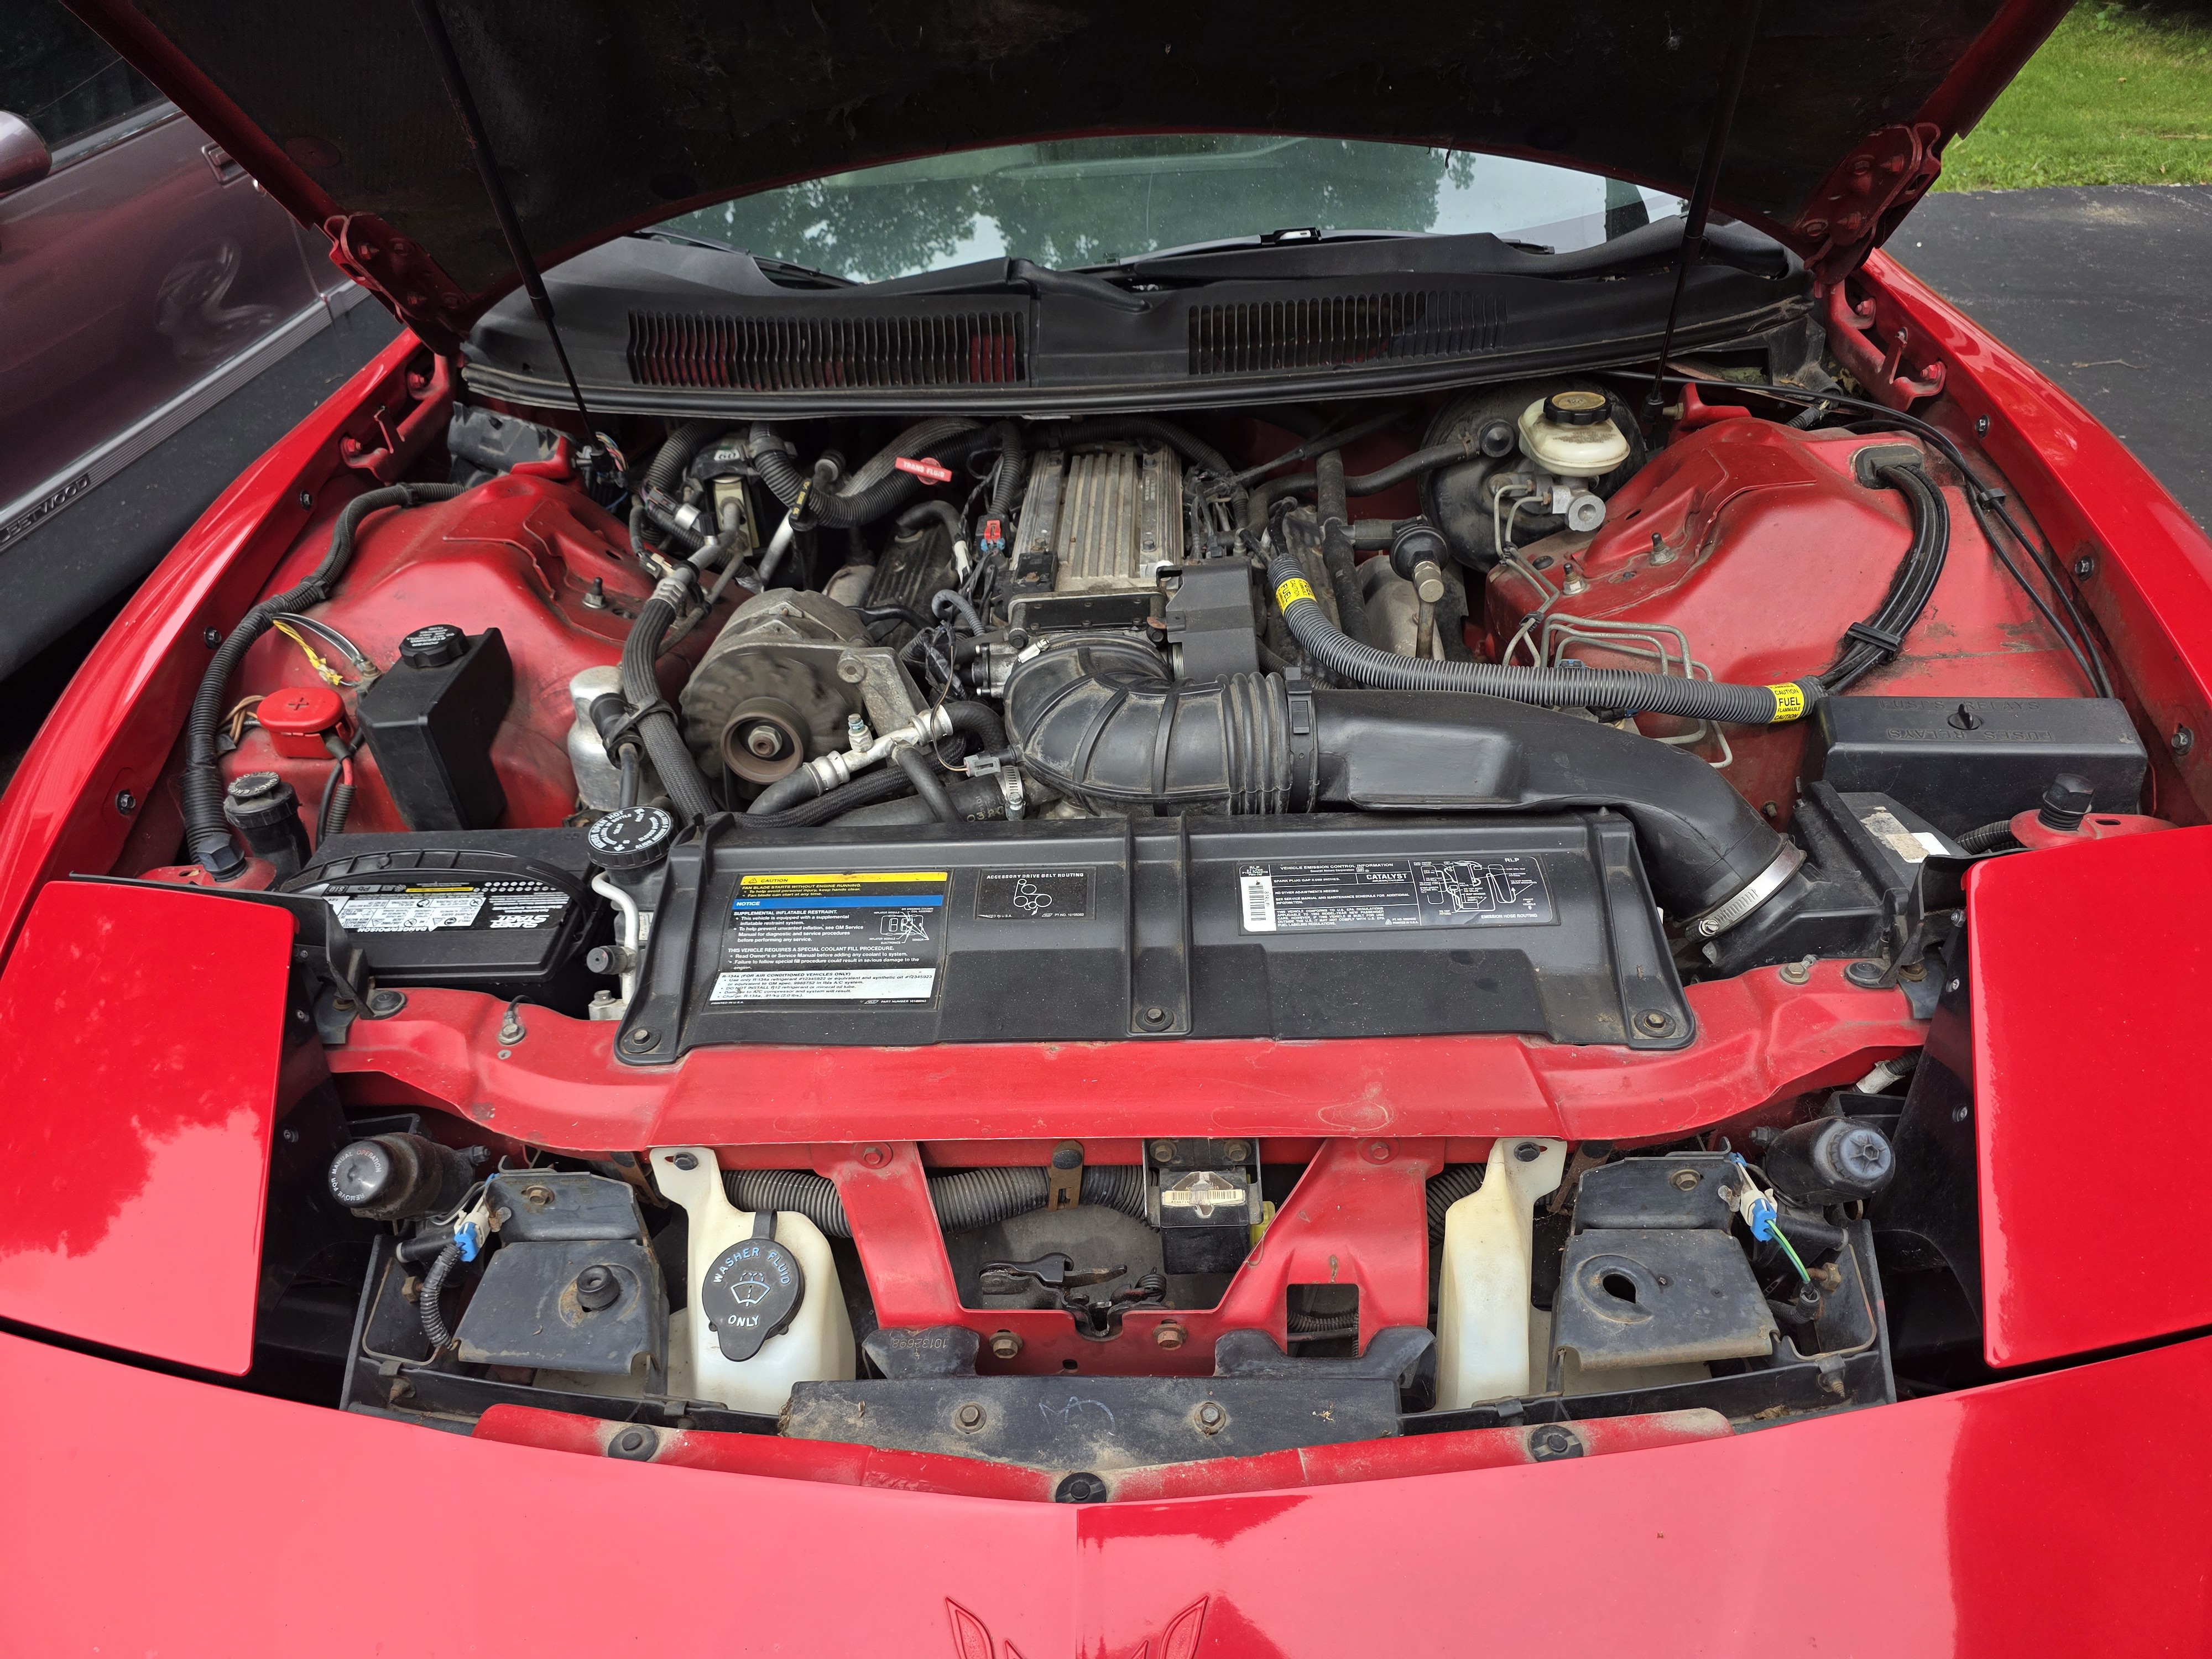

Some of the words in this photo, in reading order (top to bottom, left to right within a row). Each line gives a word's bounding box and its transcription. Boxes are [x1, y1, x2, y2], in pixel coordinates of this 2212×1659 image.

[903, 461, 925, 473] TRANS
[926, 468, 945, 478] FLUID
[1281, 583, 1291, 603] FUEL
[1290, 580, 1301, 597] CAUTION
[1779, 697, 1801, 707] FUEL
[1888, 729, 1966, 739] RELAYS
[1984, 731, 2054, 740] FUSES
[255, 779, 278, 792] ONLY
[607, 811, 624, 820] HOT
[611, 813, 632, 823] BOTTLE
[592, 820, 608, 833] OPEN
[591, 833, 607, 849] NEVER
[332, 1151, 354, 1174] MANUAL
[357, 1150, 382, 1172] OPERATION
[338, 1191, 365, 1201] REMOVE
[713, 1247, 760, 1283] WASHER
[767, 1251, 790, 1285] FLUID
[728, 1315, 759, 1327] ONLY
[892, 1338, 947, 1348] 10132698
